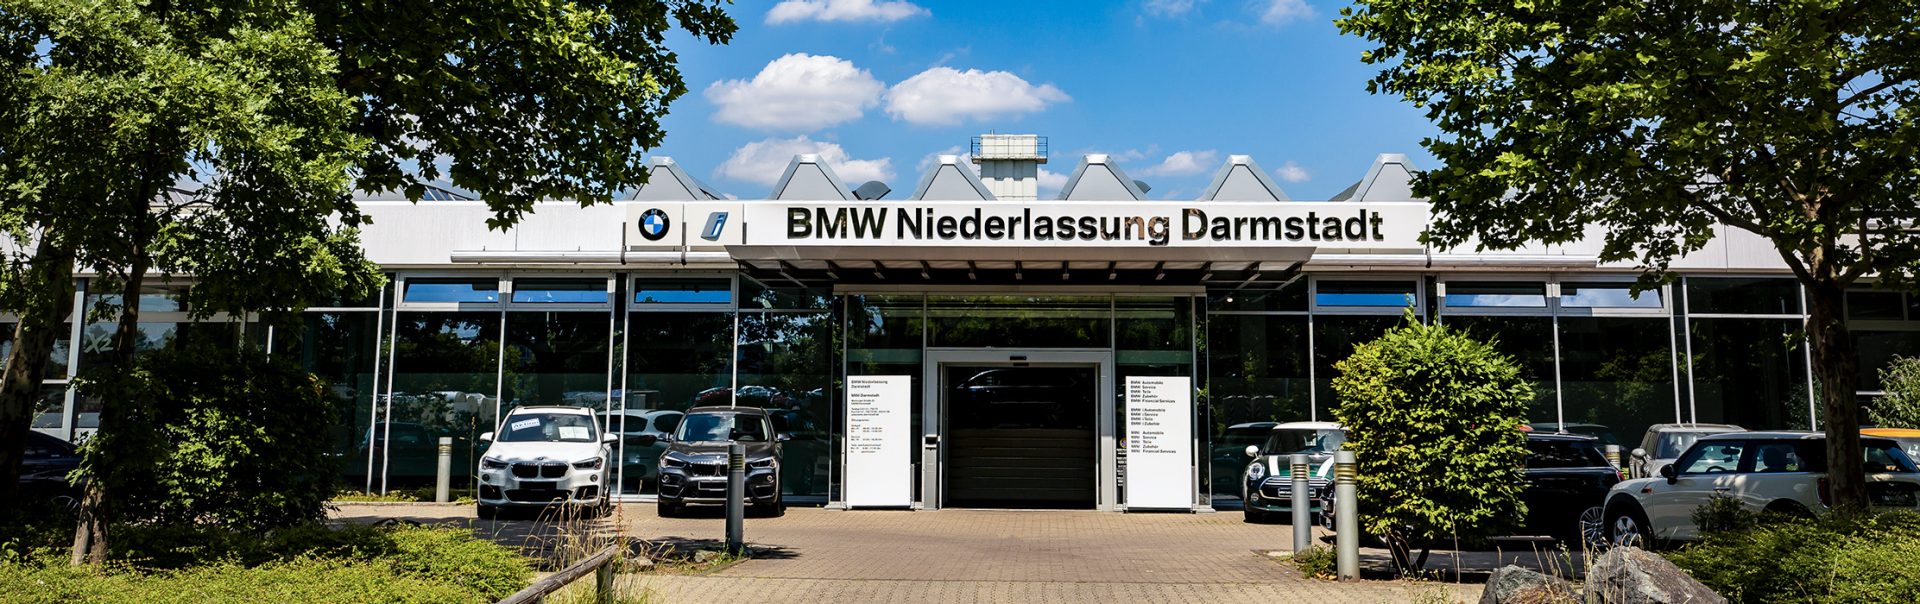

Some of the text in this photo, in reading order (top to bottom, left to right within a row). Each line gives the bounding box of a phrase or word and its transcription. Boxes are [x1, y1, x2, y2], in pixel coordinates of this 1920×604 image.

[787, 207, 1384, 246] BMW Niederlassung Darmstadt
[84, 332, 114, 355] X2
